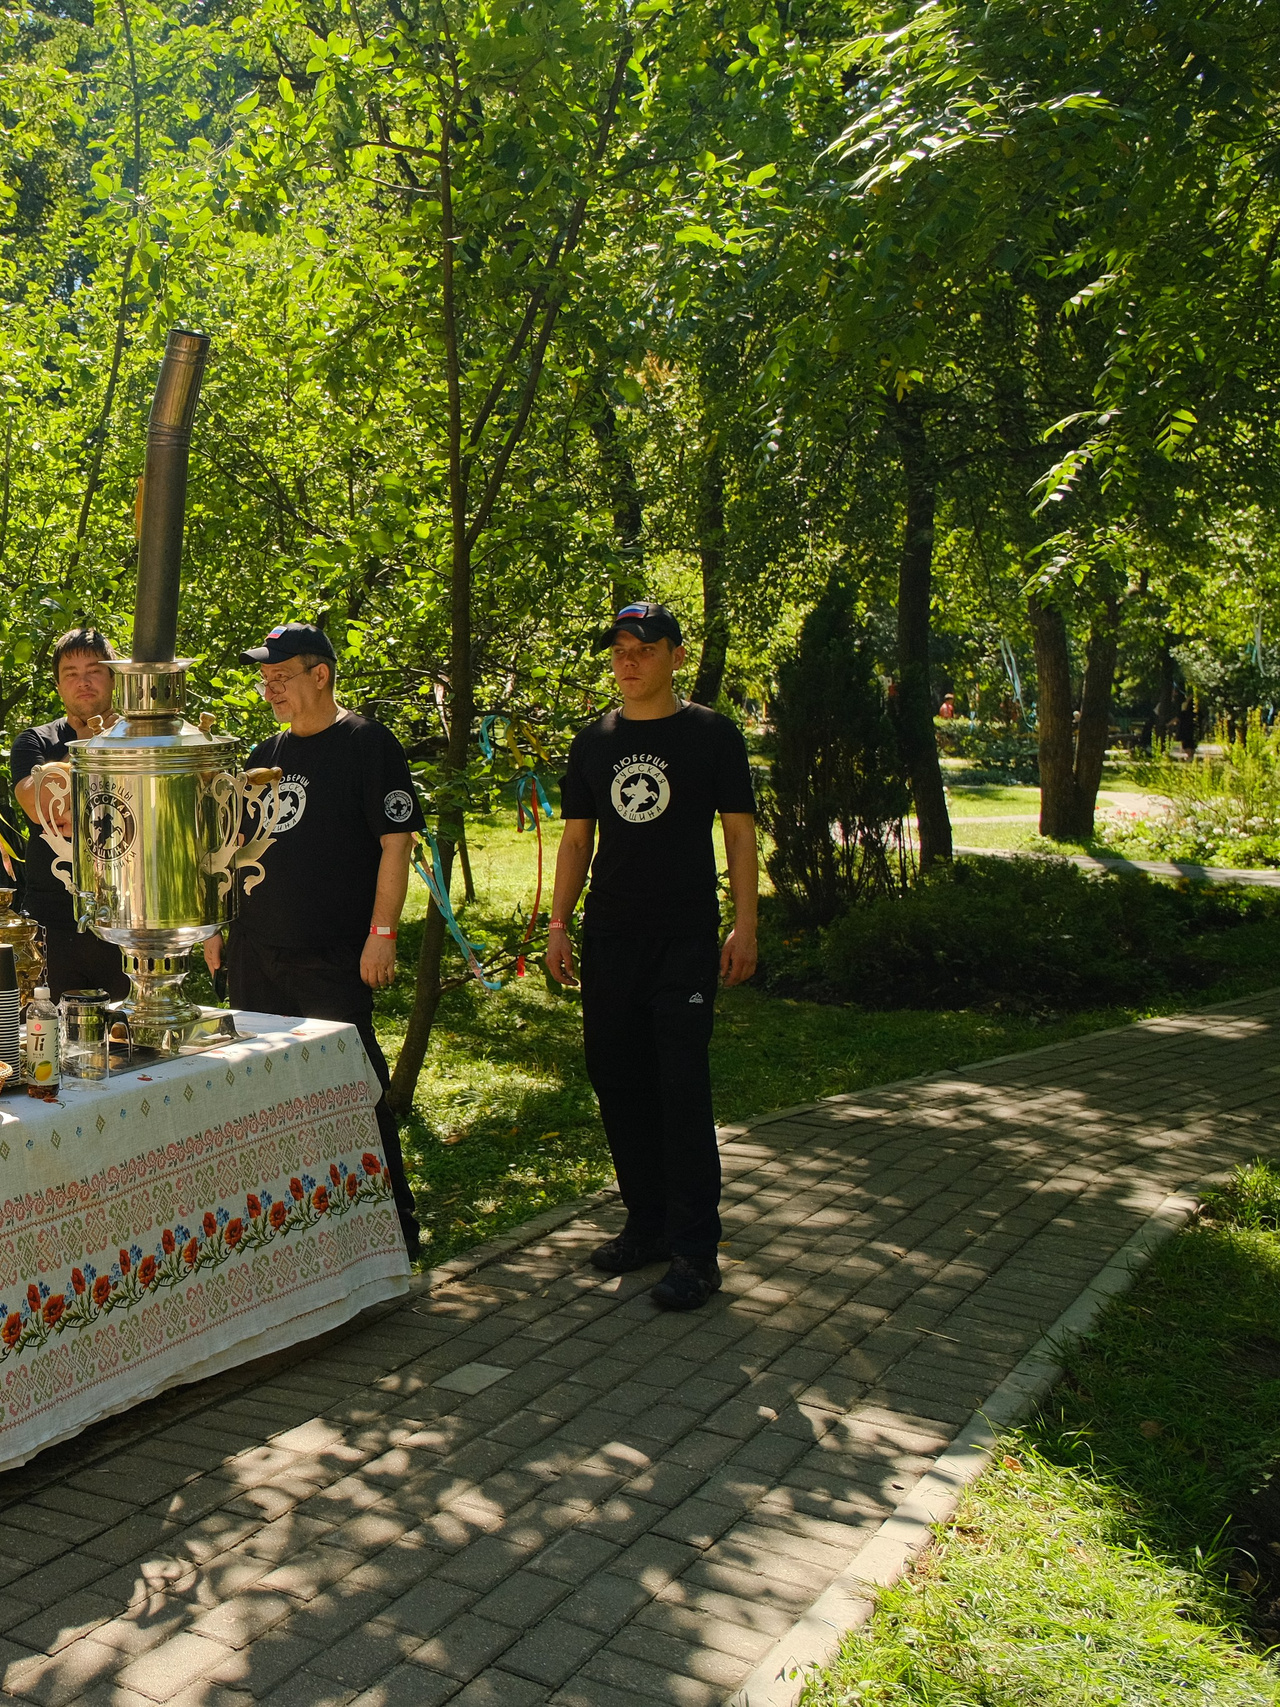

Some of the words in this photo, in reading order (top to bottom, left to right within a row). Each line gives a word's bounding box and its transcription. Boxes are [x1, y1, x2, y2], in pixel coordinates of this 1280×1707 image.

[613, 754, 669, 773] ЛЮБЕРЦЫ
[280, 774, 310, 787] БЕРЦЫ
[615, 764, 666, 784] РУССКАЯ
[84, 781, 134, 801] ЛЮБЕРЦЫ
[268, 784, 306, 800] РССКАЯ
[86, 795, 131, 819] РУССКАЯ
[617, 804, 662, 821] ОБЩИНА
[87, 837, 129, 857] ОБЩИНА
[31, 1032, 47, 1051] Ti
